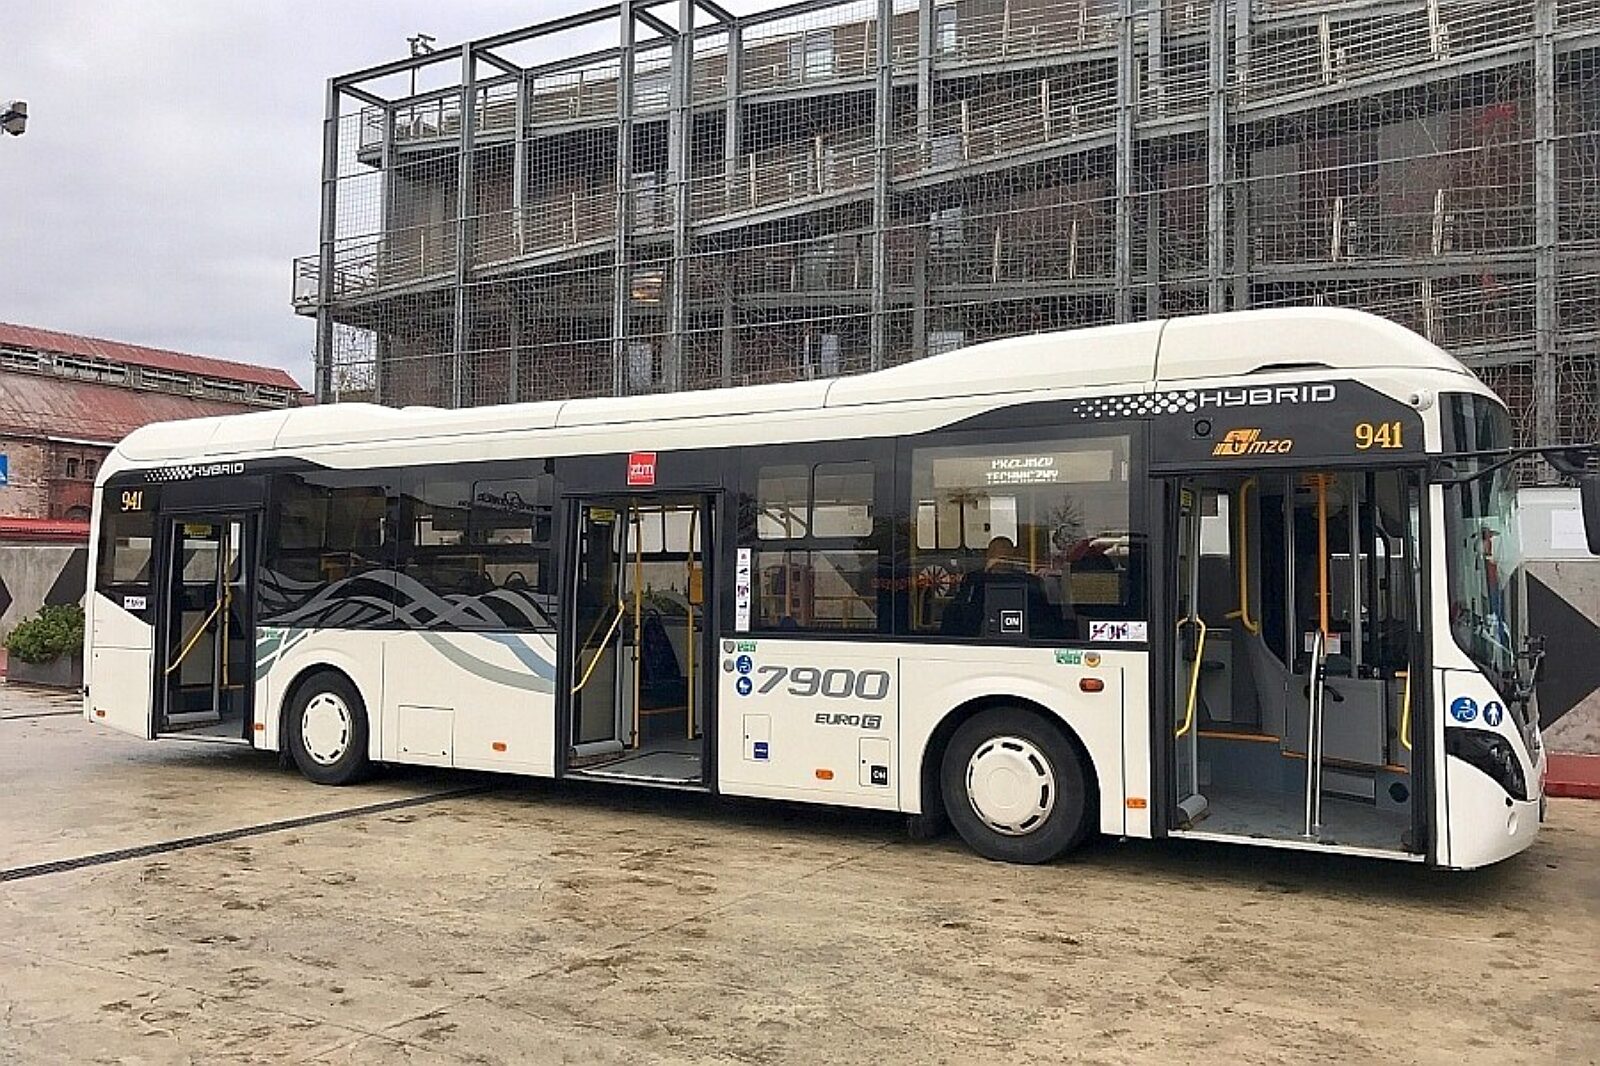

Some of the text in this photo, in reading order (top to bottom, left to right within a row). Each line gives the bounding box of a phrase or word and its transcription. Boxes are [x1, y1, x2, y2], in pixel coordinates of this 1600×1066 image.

[1200, 384, 1336, 408] HYBRID
[1354, 421, 1404, 450] 941
[1247, 439, 1292, 454] mza
[193, 462, 244, 477] HYBRID
[121, 491, 143, 511] 941
[1004, 617, 1020, 626] ON
[757, 665, 890, 700] 7900
[815, 713, 860, 726] EURO
